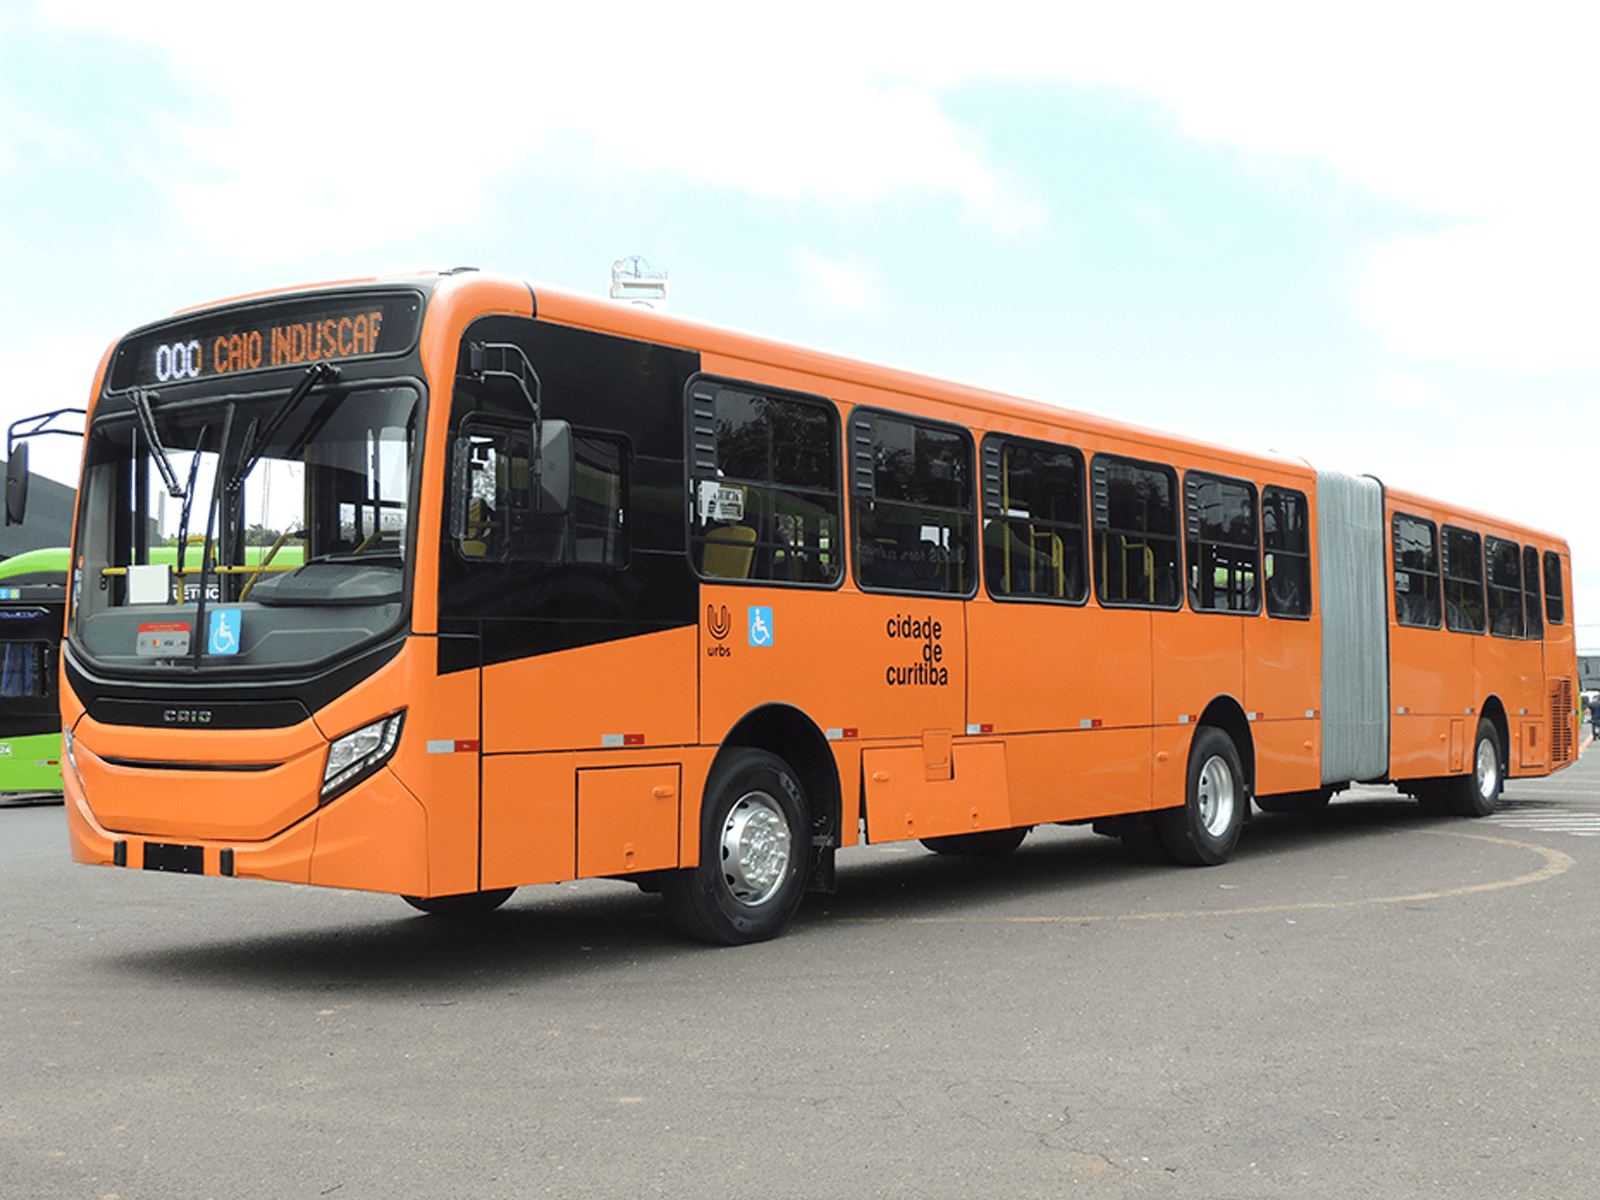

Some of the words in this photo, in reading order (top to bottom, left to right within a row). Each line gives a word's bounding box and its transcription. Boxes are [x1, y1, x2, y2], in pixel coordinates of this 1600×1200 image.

[214, 330, 263, 373] CAIO
[887, 613, 942, 640] cidade
[706, 643, 731, 657] urbs
[922, 639, 942, 662] de
[886, 661, 948, 686] curitiba
[163, 710, 211, 722] CAIO
